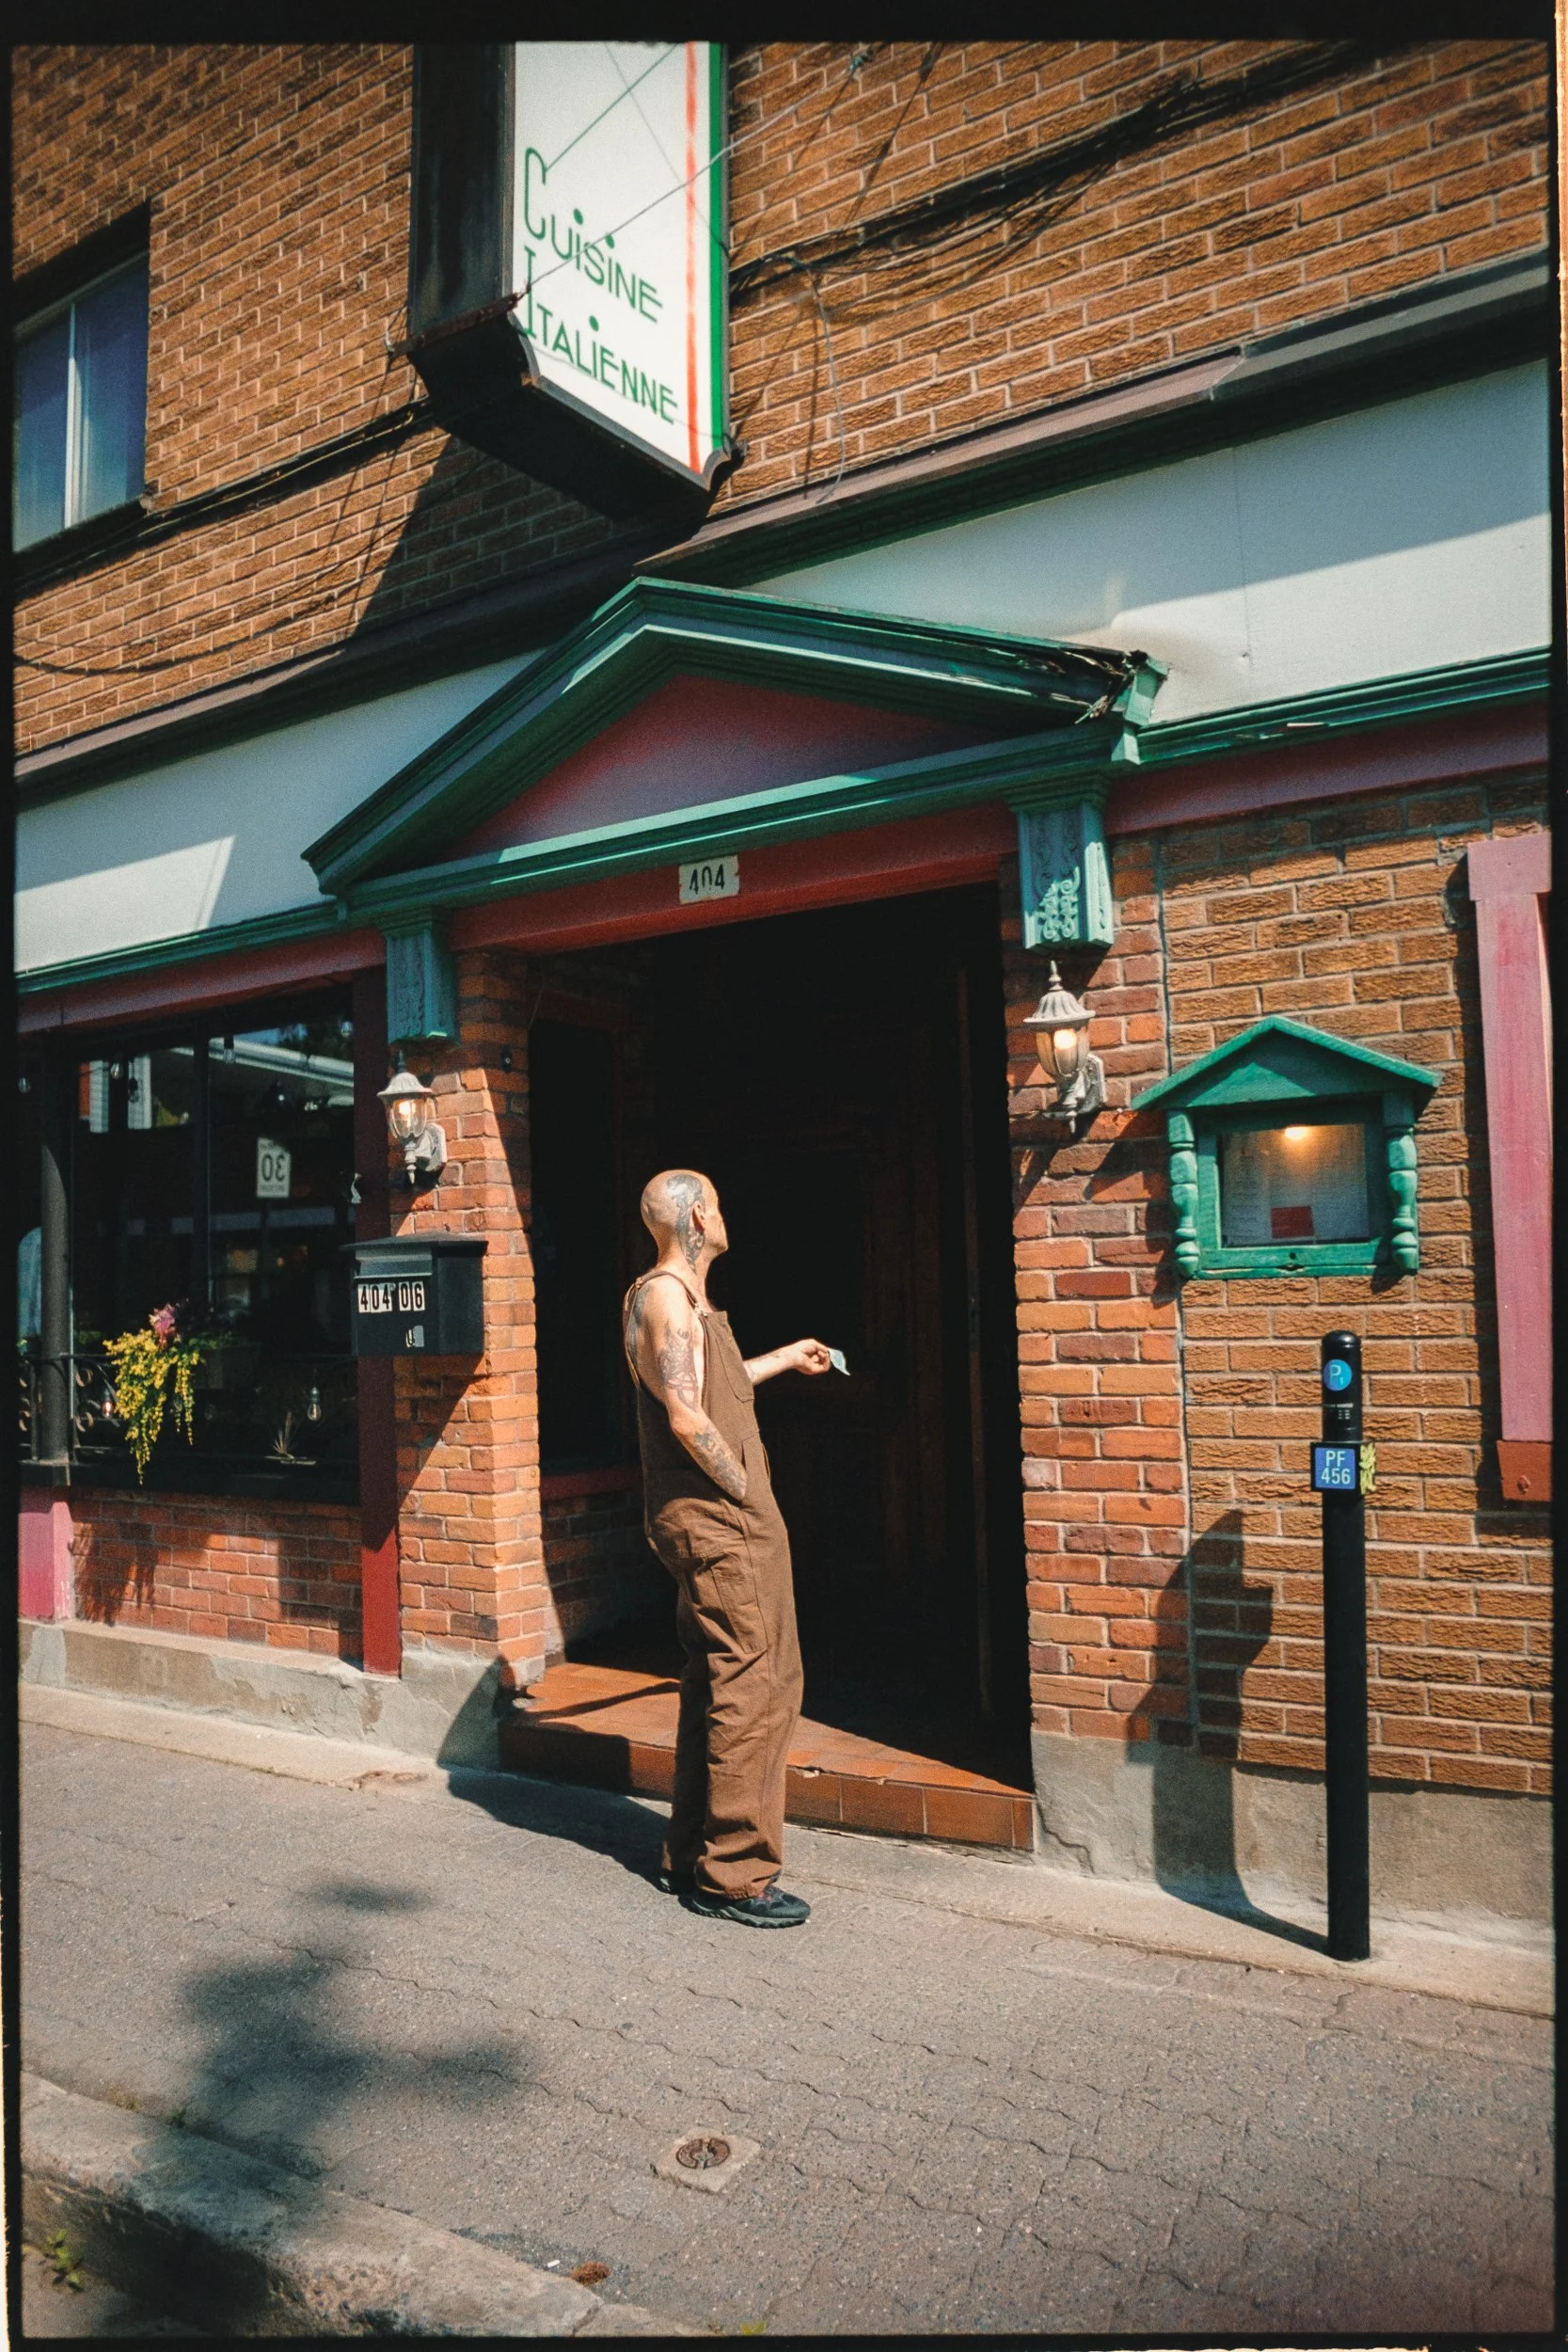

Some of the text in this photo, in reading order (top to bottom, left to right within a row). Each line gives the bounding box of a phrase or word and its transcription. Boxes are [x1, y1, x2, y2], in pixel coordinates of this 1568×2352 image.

[360, 1284, 389, 1310] 404
[1325, 1450, 1346, 1467] PF
[1321, 1468, 1351, 1485] 456
